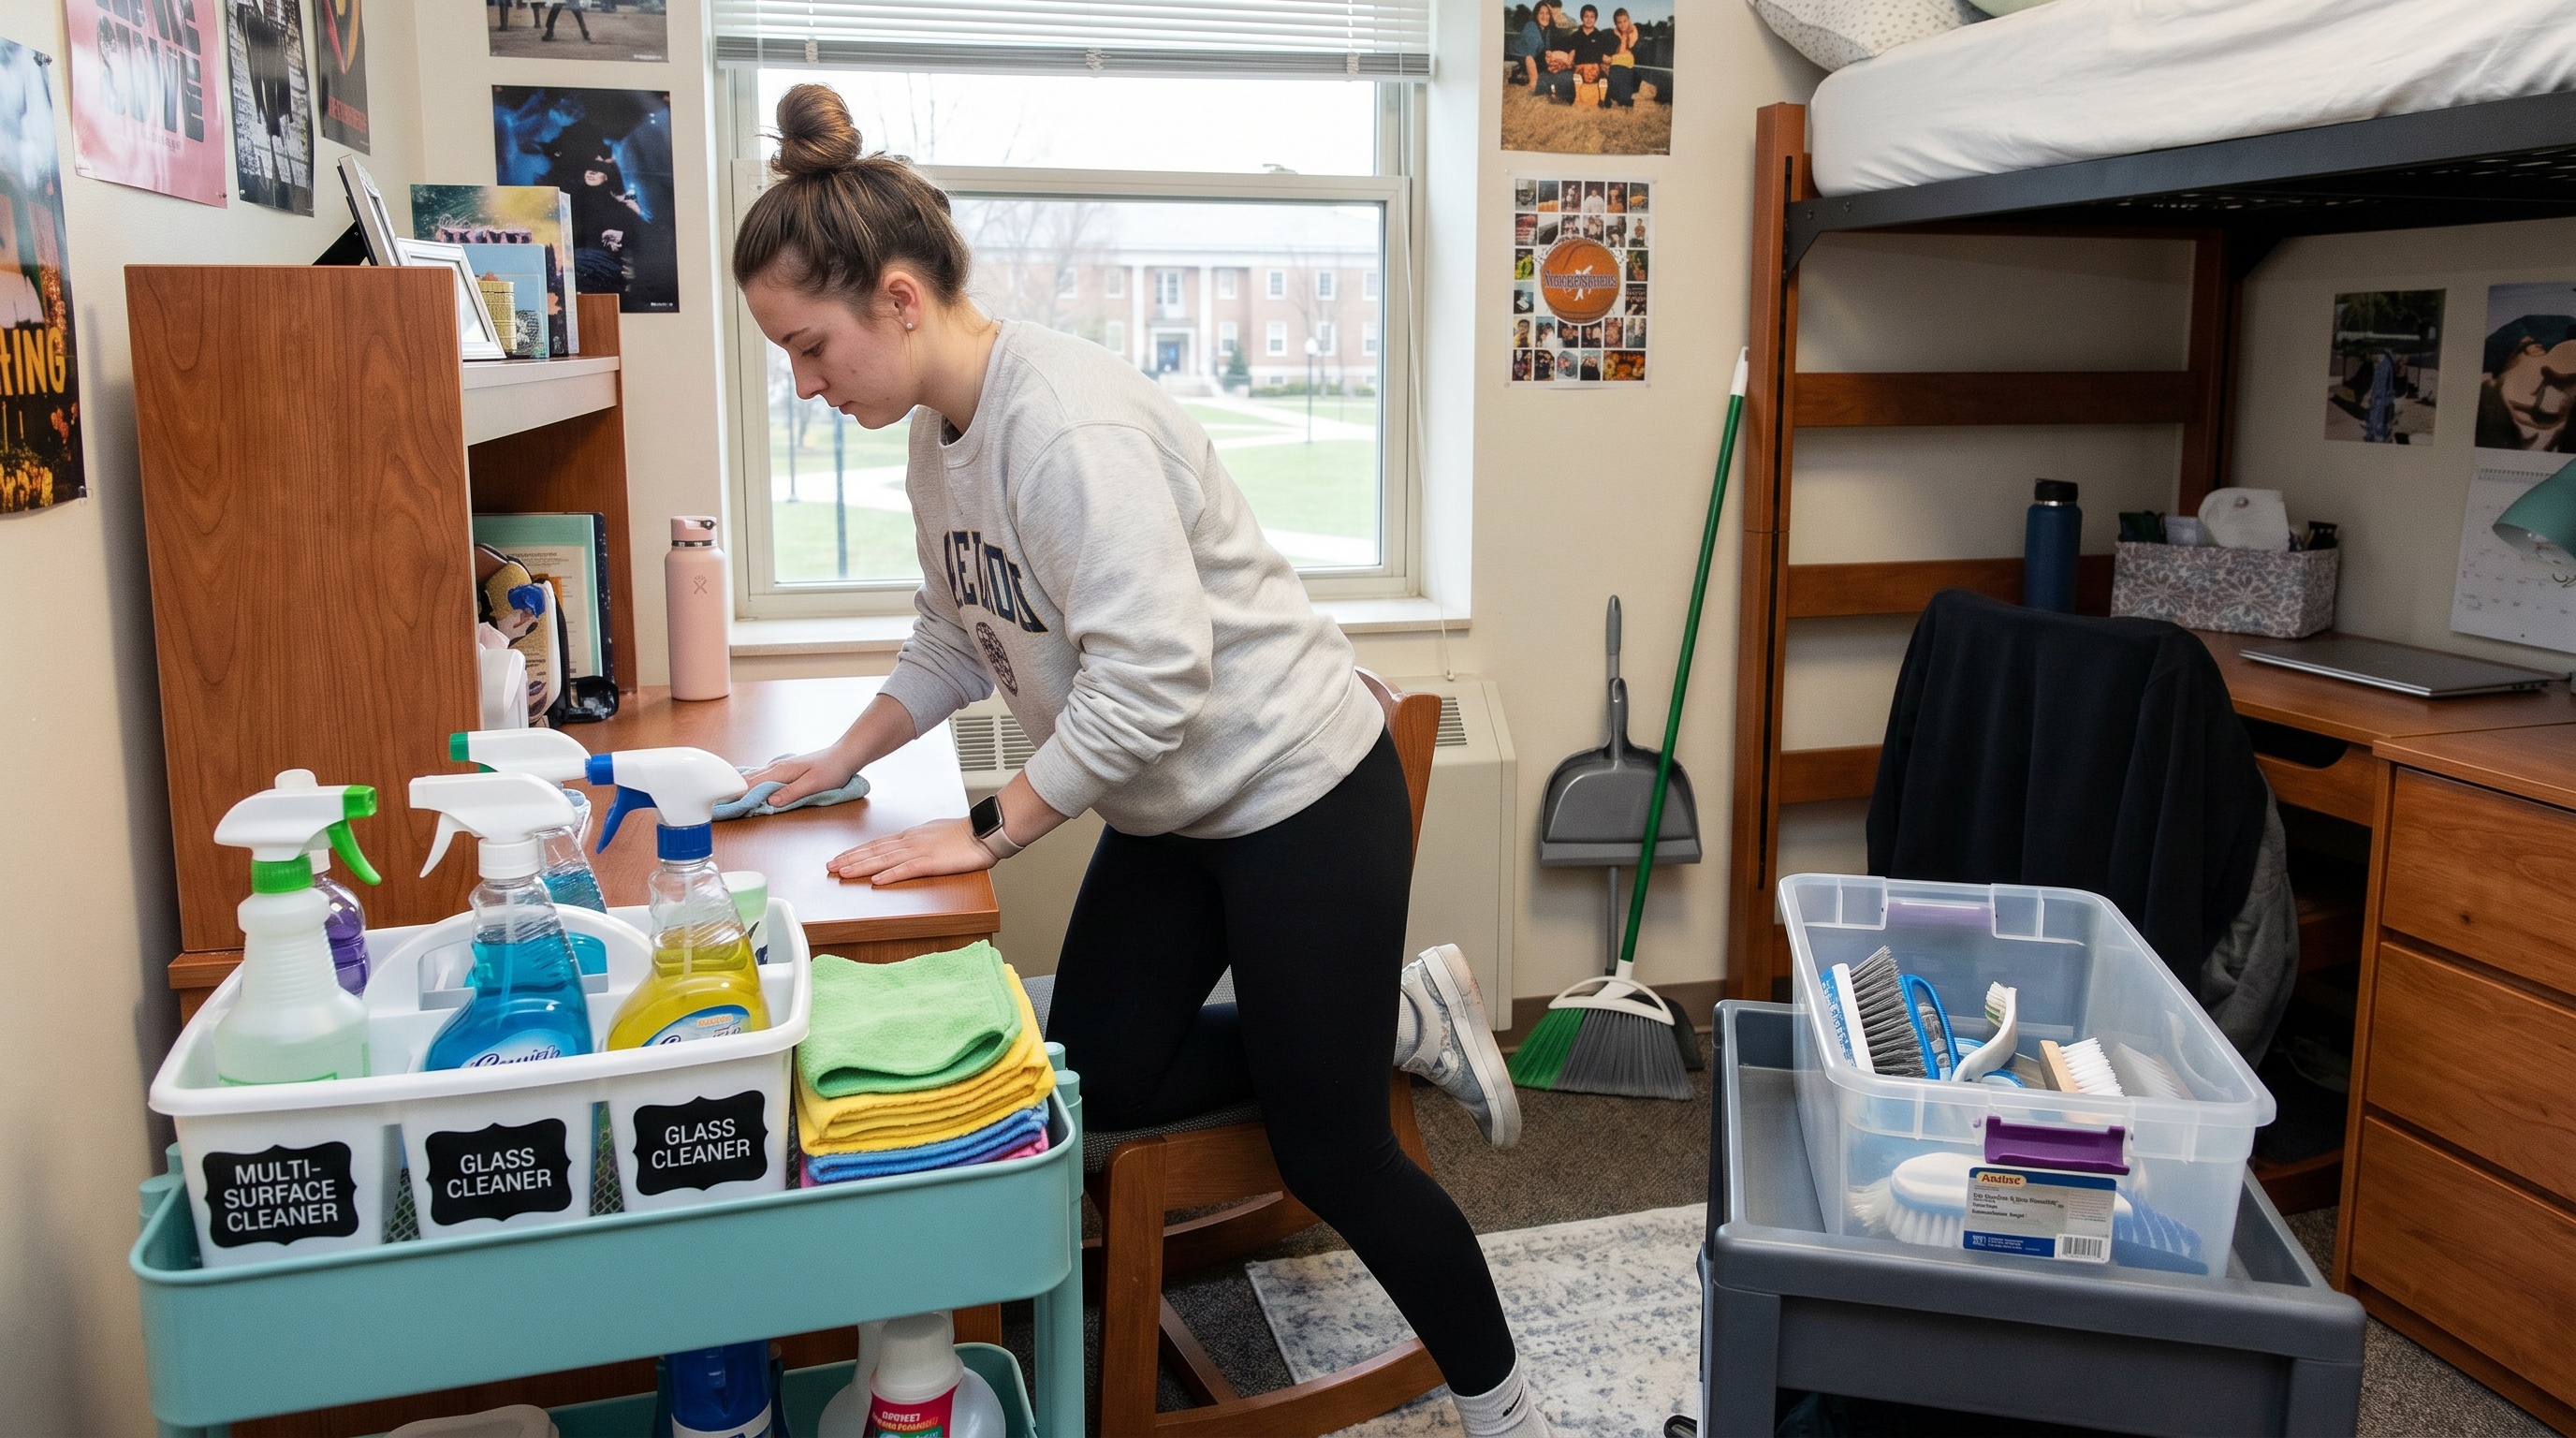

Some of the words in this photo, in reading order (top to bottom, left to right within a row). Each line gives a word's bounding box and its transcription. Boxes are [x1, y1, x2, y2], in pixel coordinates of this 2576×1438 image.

[665, 1118, 736, 1146] GLASS
[460, 1147, 535, 1175] GLASS
[651, 1138, 751, 1169] CLEANER
[235, 1158, 322, 1185] MULTI-
[446, 1168, 552, 1198] CLEANER
[223, 1179, 337, 1210] SURFACE
[227, 1202, 339, 1232] CLEANER
